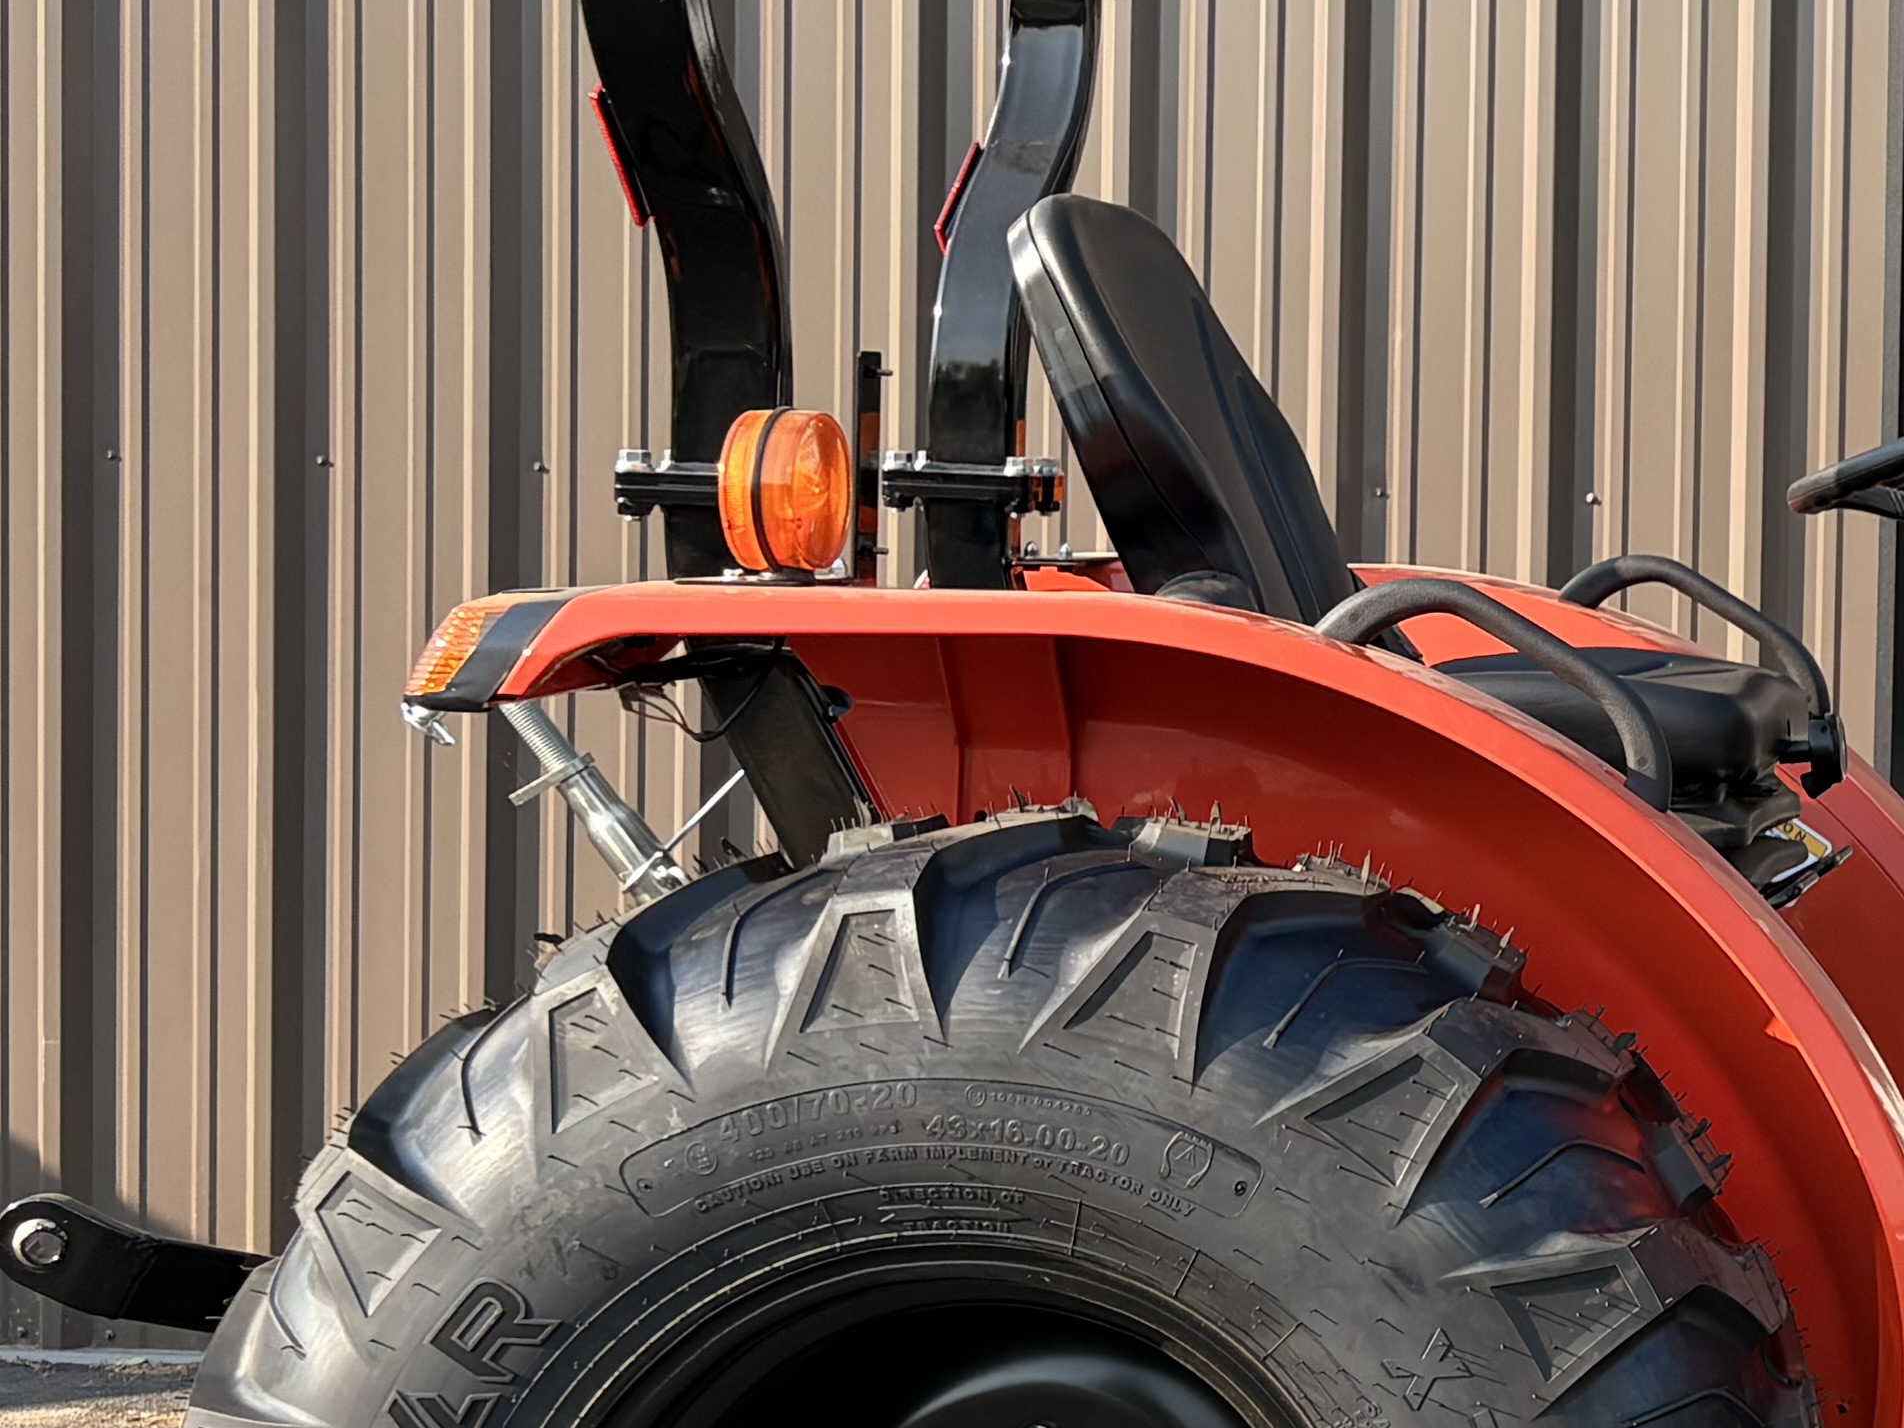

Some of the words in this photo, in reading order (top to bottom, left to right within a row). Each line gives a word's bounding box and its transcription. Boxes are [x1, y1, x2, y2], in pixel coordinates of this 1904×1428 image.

[786, 1157, 824, 1178] USE
[830, 1152, 857, 1169] ON
[863, 1146, 917, 1164] FARM
[925, 1146, 1029, 1167] IMPLEMENT
[1057, 1157, 1145, 1197] TRACTOR
[1145, 1184, 1196, 1219] ONLY
